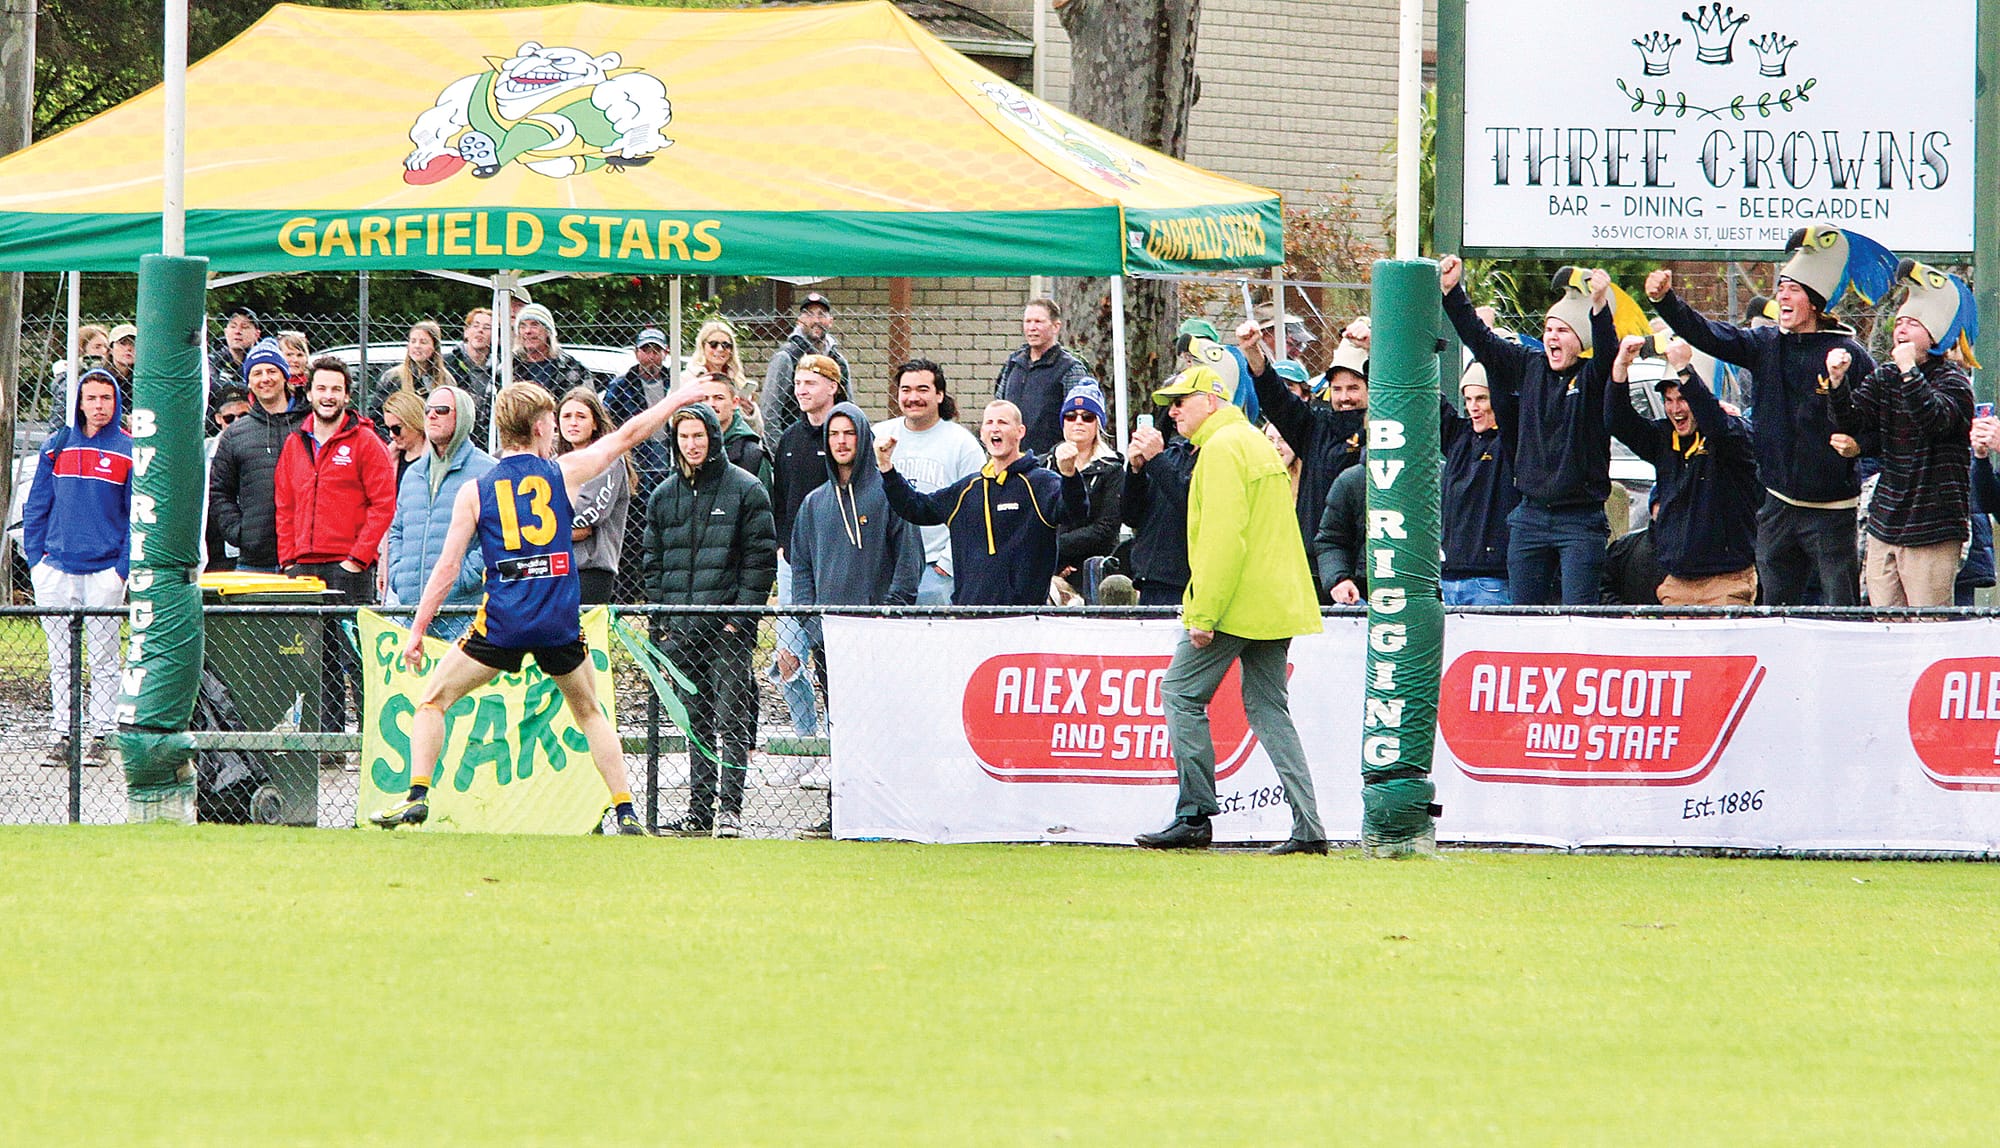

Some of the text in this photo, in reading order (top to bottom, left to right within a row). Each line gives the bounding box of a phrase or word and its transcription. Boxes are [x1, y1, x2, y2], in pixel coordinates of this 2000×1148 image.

[1485, 127, 1951, 190] THREE CROWNS
[1548, 195, 1589, 216] BAR
[1623, 196, 1703, 217] DINING
[1739, 198, 1890, 219] BEERGARDEN
[277, 212, 723, 261] GARFIELD STARS
[1146, 213, 1266, 260] GARFIELD STARS
[1591, 225, 1689, 240] 365VICTORIA
[1716, 226, 1753, 241] WEST
[494, 475, 558, 551] 13
[1364, 420, 1407, 767] BV RIGGING
[994, 666, 1168, 716] ALEX SCO
[1469, 664, 1692, 718] ALEX SCOTT
[1939, 671, 2000, 721] ALE
[1050, 723, 1175, 760] AND STA
[1526, 723, 1680, 761] AND STAFF
[1248, 785, 1289, 810] 188
[1682, 789, 1765, 819] Est. 1886
